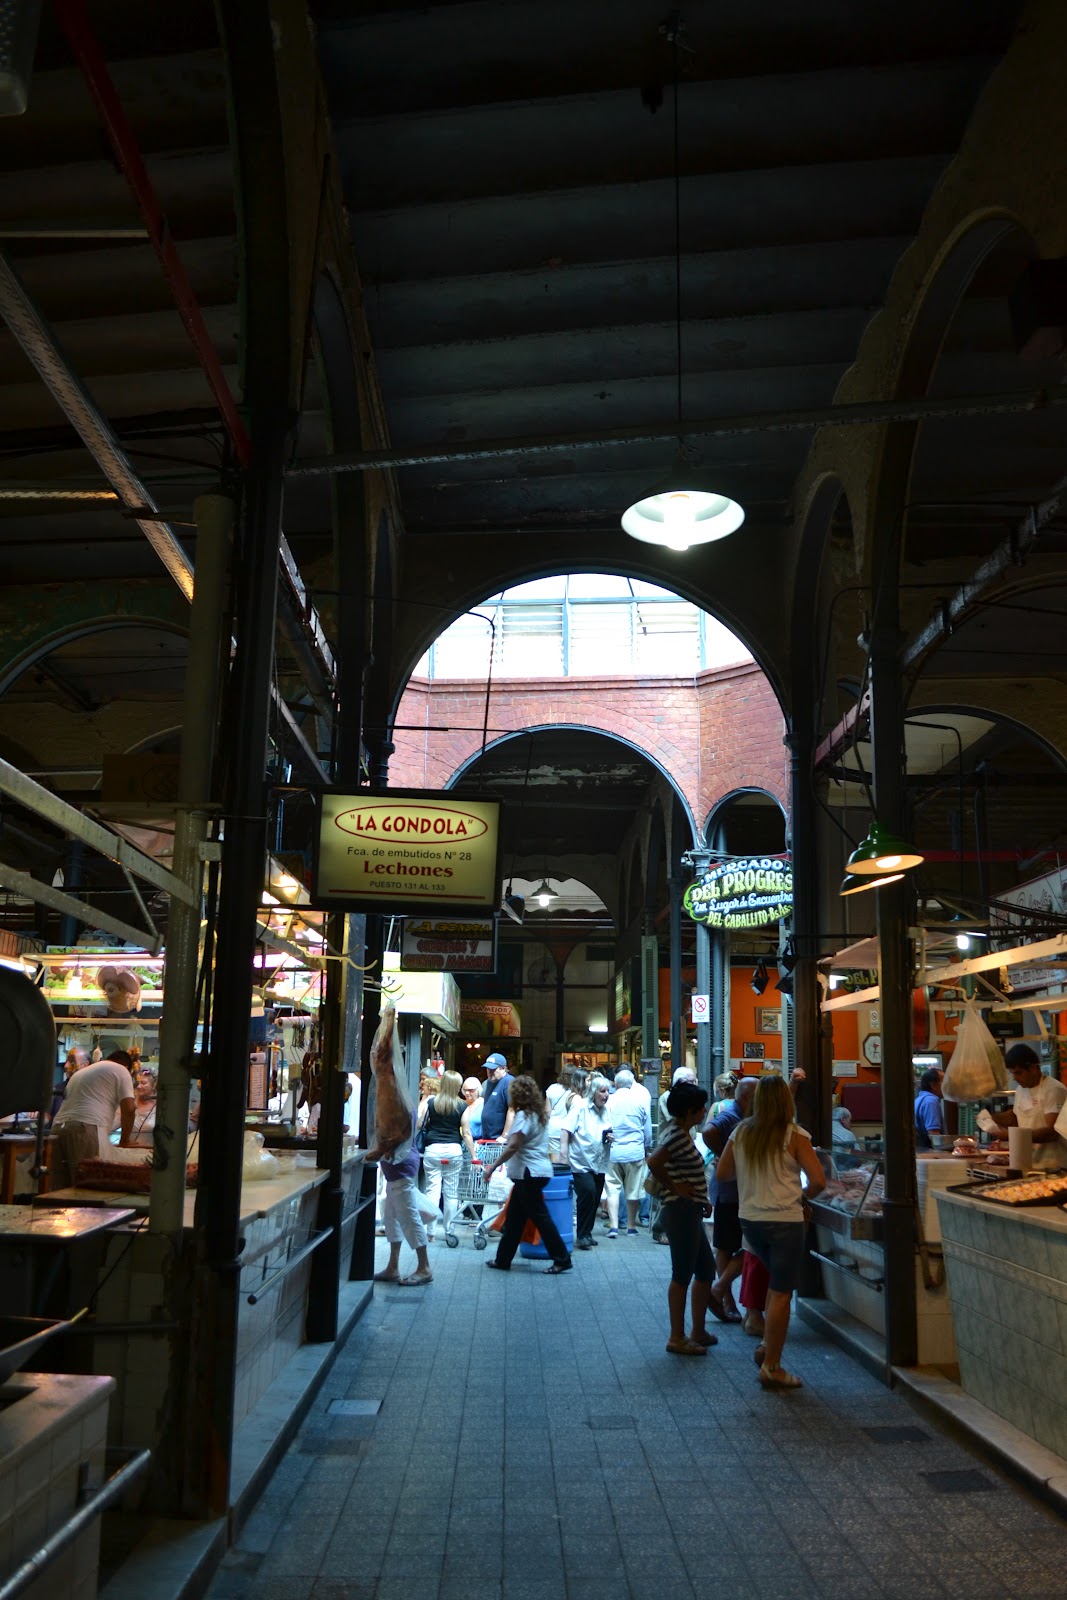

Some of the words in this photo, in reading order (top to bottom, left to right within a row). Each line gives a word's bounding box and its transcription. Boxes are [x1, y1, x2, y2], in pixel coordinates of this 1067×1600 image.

[347, 847, 369, 856] Fca.
[372, 848, 385, 857] de
[388, 849, 441, 859] embutidos
[459, 852, 472, 861] 28
[363, 860, 453, 878] Lechones
[704, 859, 784, 883] MERCADO
[370, 880, 402, 889] PUESTO
[404, 882, 417, 890] 131
[419, 883, 430, 891] AL
[432, 883, 445, 892] 133
[692, 881, 720, 902] DEL
[722, 870, 793, 897] PROGRES
[709, 898, 740, 915] Lugar
[405, 921, 431, 932] LA
[435, 922, 490, 932] GONDOLA
